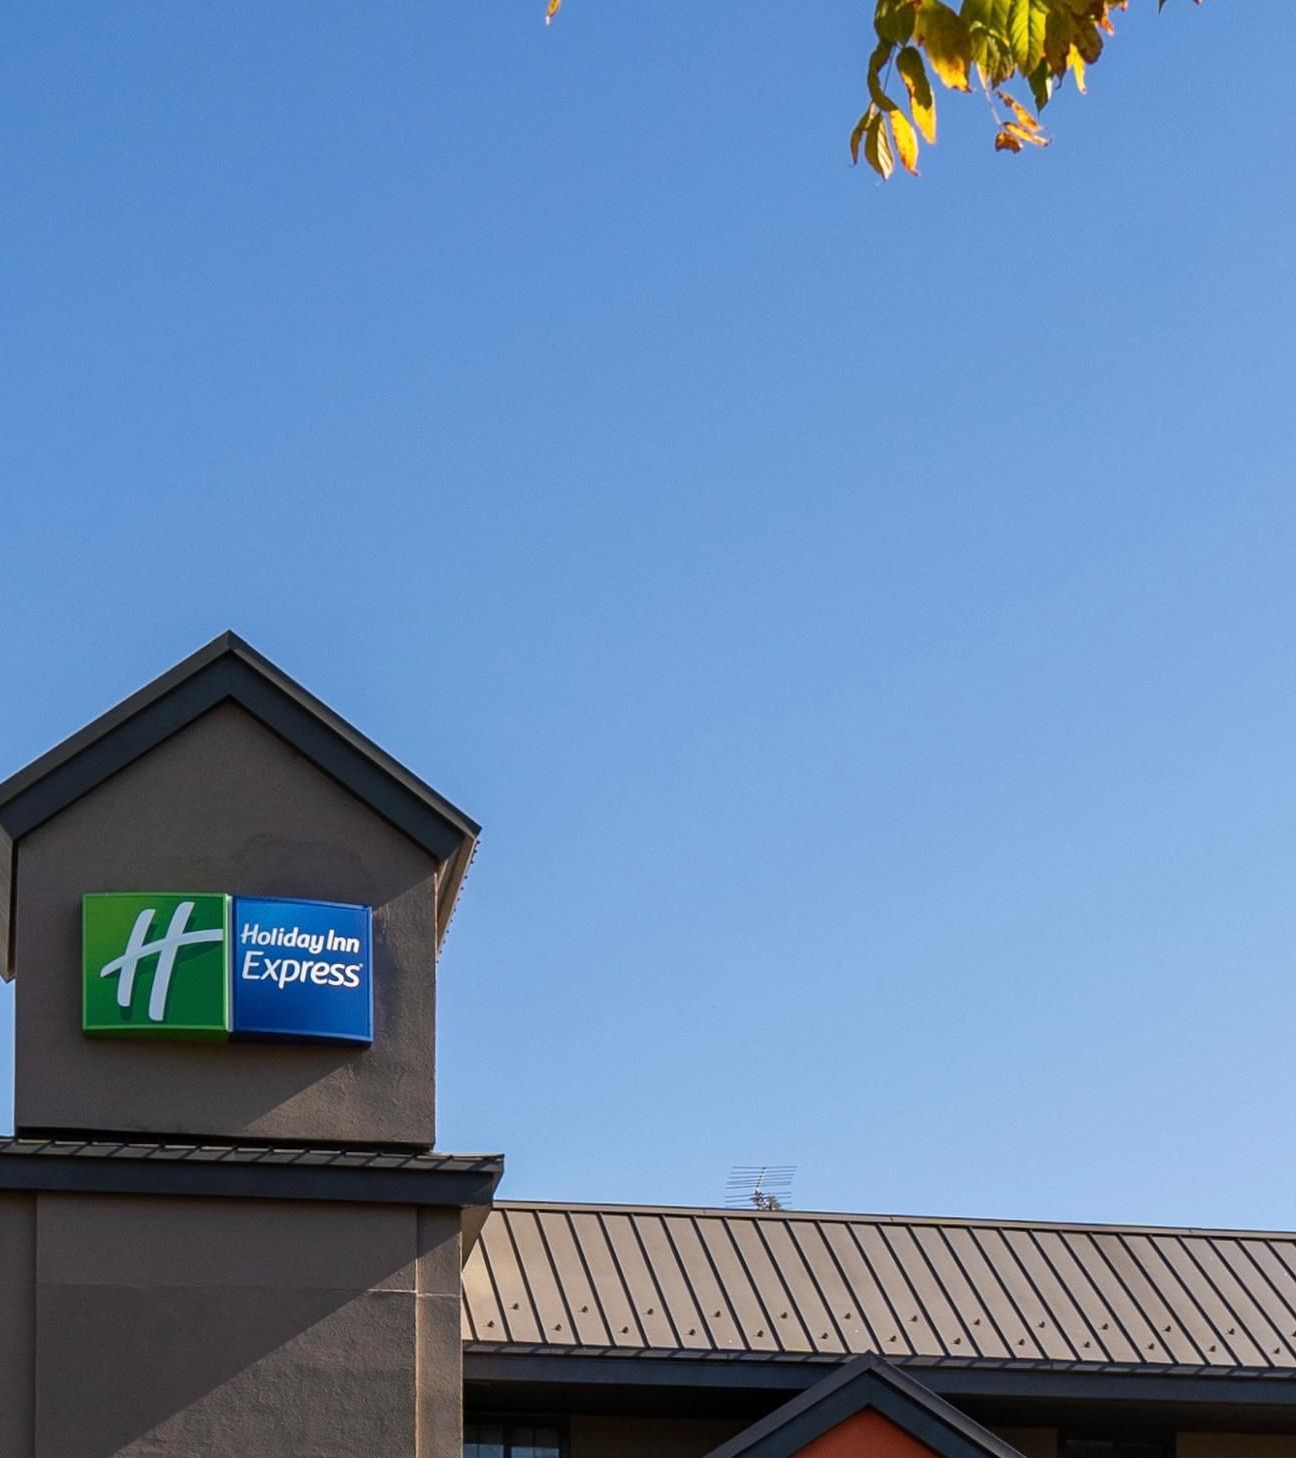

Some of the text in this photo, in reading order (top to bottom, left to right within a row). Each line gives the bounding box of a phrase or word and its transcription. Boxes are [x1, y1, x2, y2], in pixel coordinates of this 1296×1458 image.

[240, 922, 360, 955] Holiday Inn
[241, 950, 361, 990] Express
